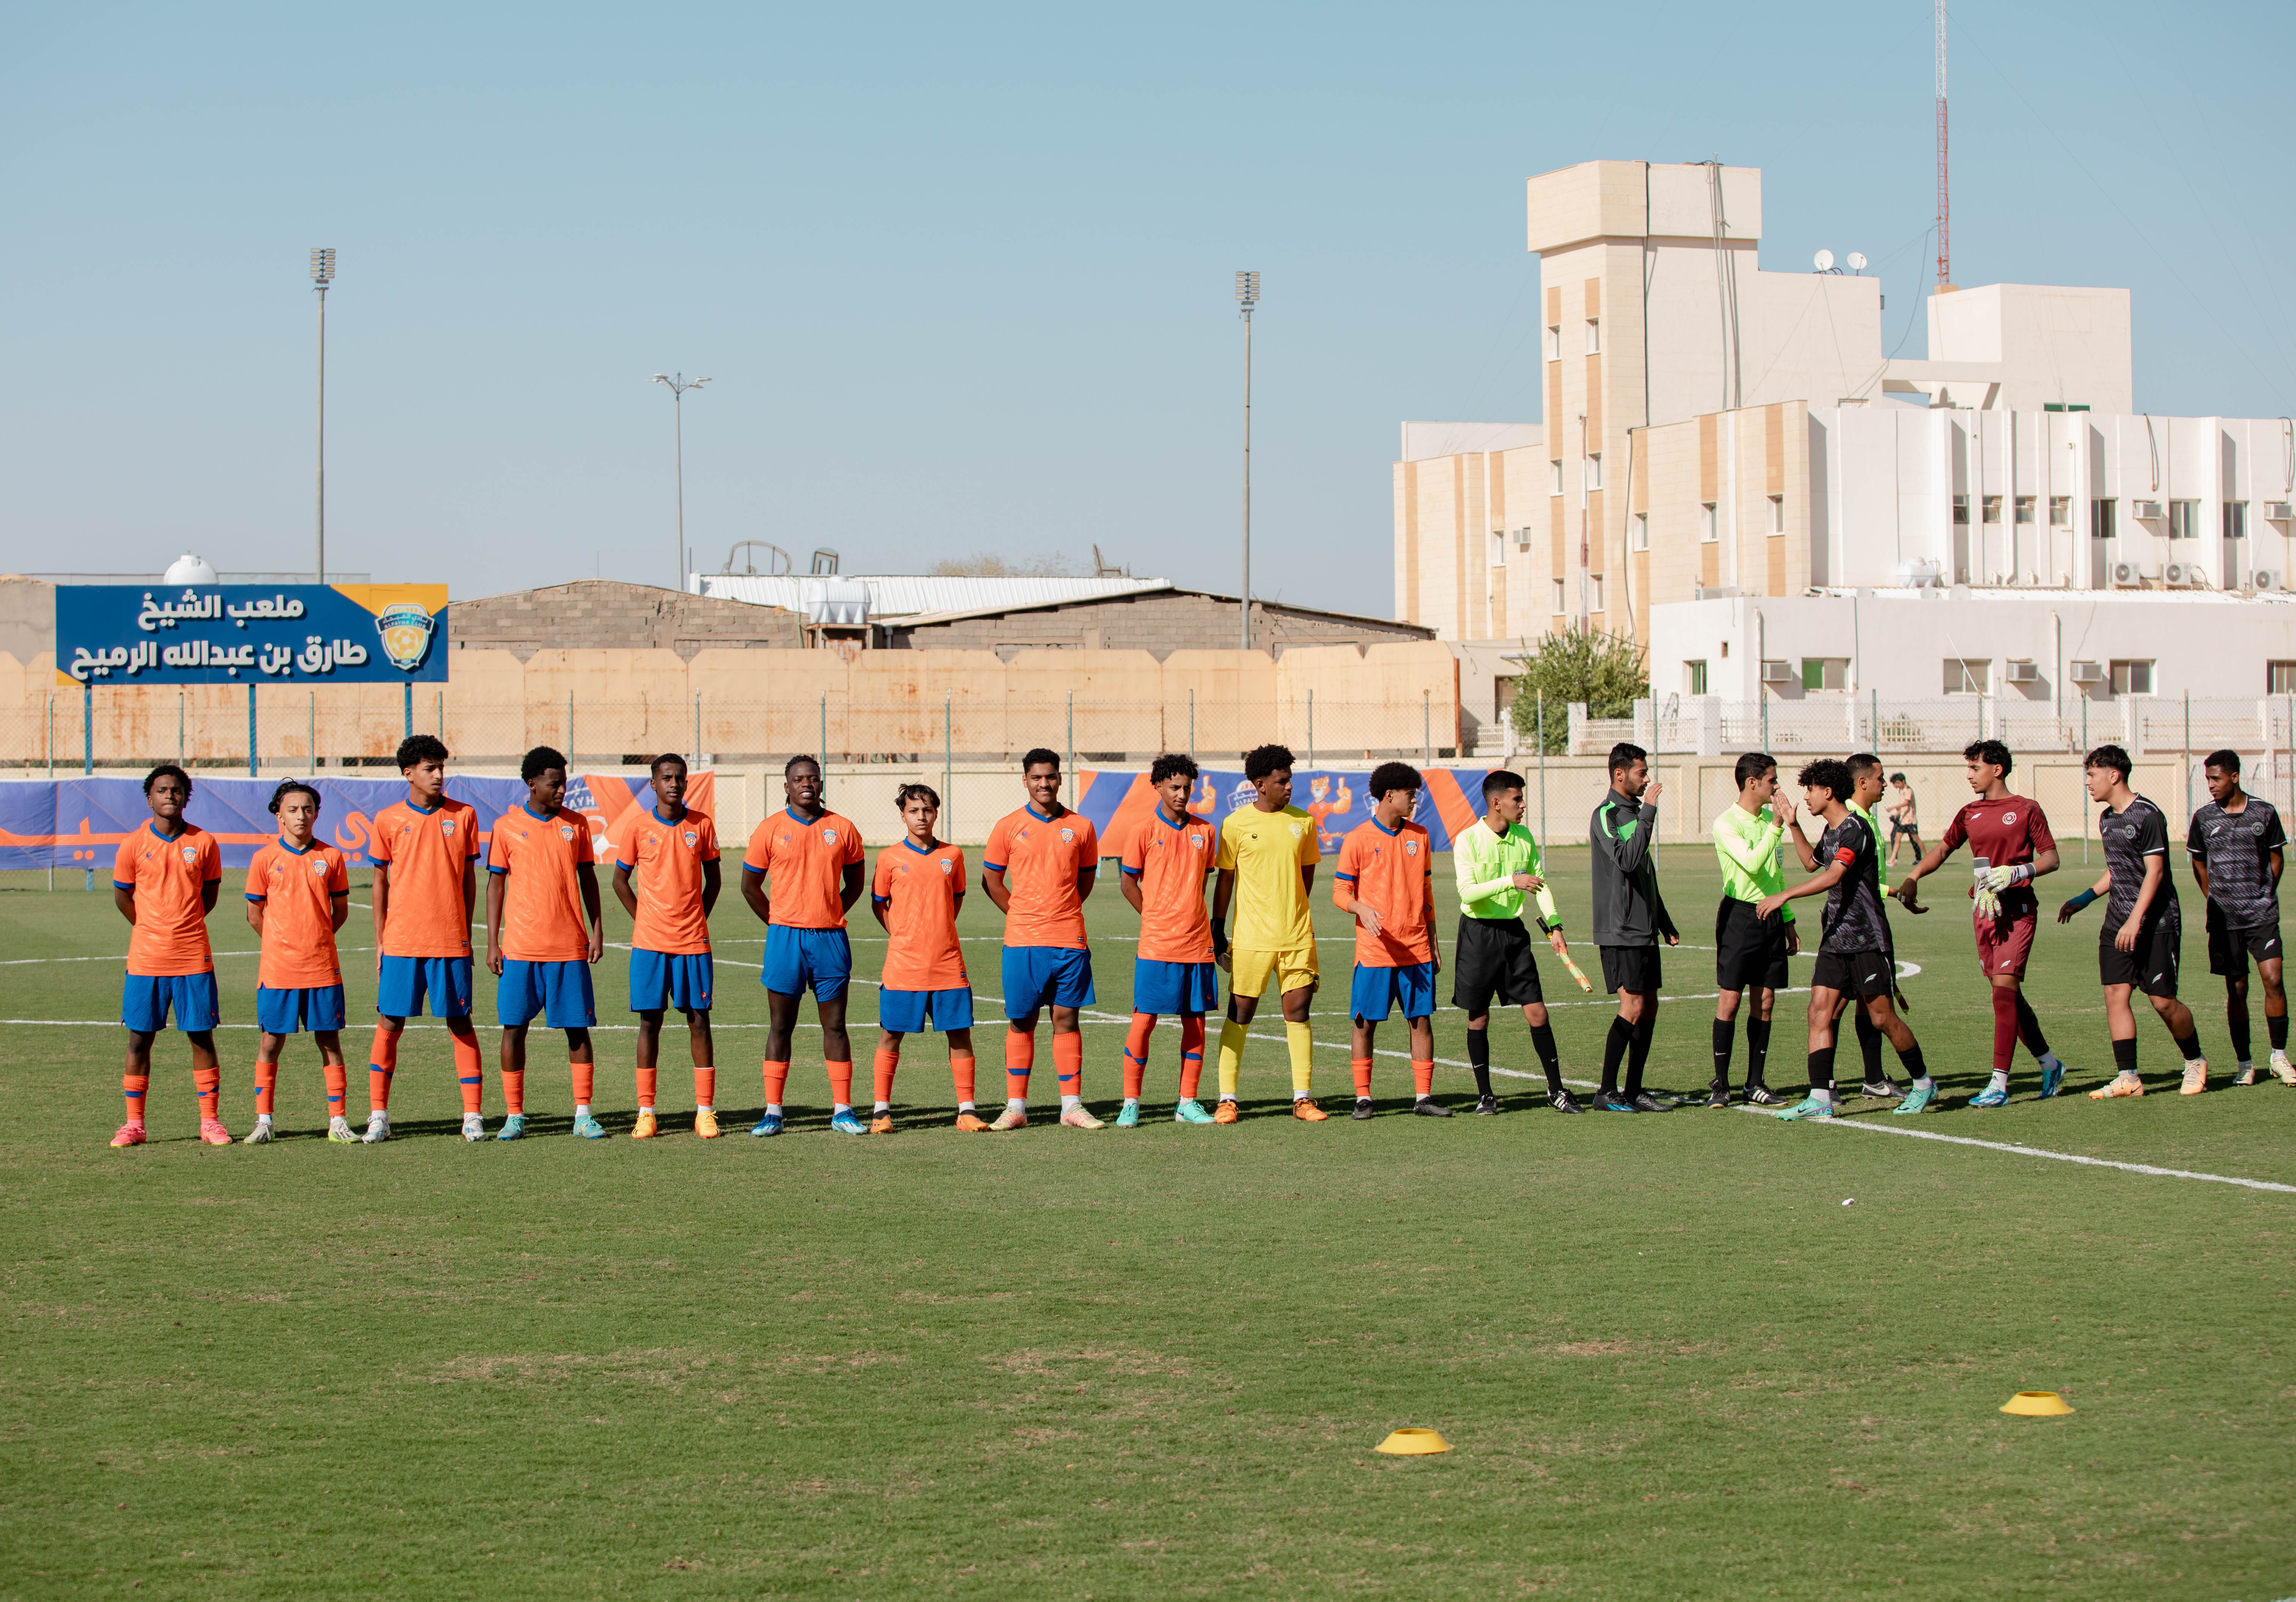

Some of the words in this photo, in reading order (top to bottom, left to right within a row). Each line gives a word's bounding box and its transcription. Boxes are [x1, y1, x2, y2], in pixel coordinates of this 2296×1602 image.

[137, 588, 221, 631] الشيخ
[227, 594, 304, 627] ملعب
[384, 620, 409, 629] ALFAYHA
[411, 620, 426, 629] CLUB
[70, 641, 157, 680] الرميح
[162, 640, 255, 676] عبدالله
[259, 643, 291, 675] بن
[297, 635, 367, 673] طارق
